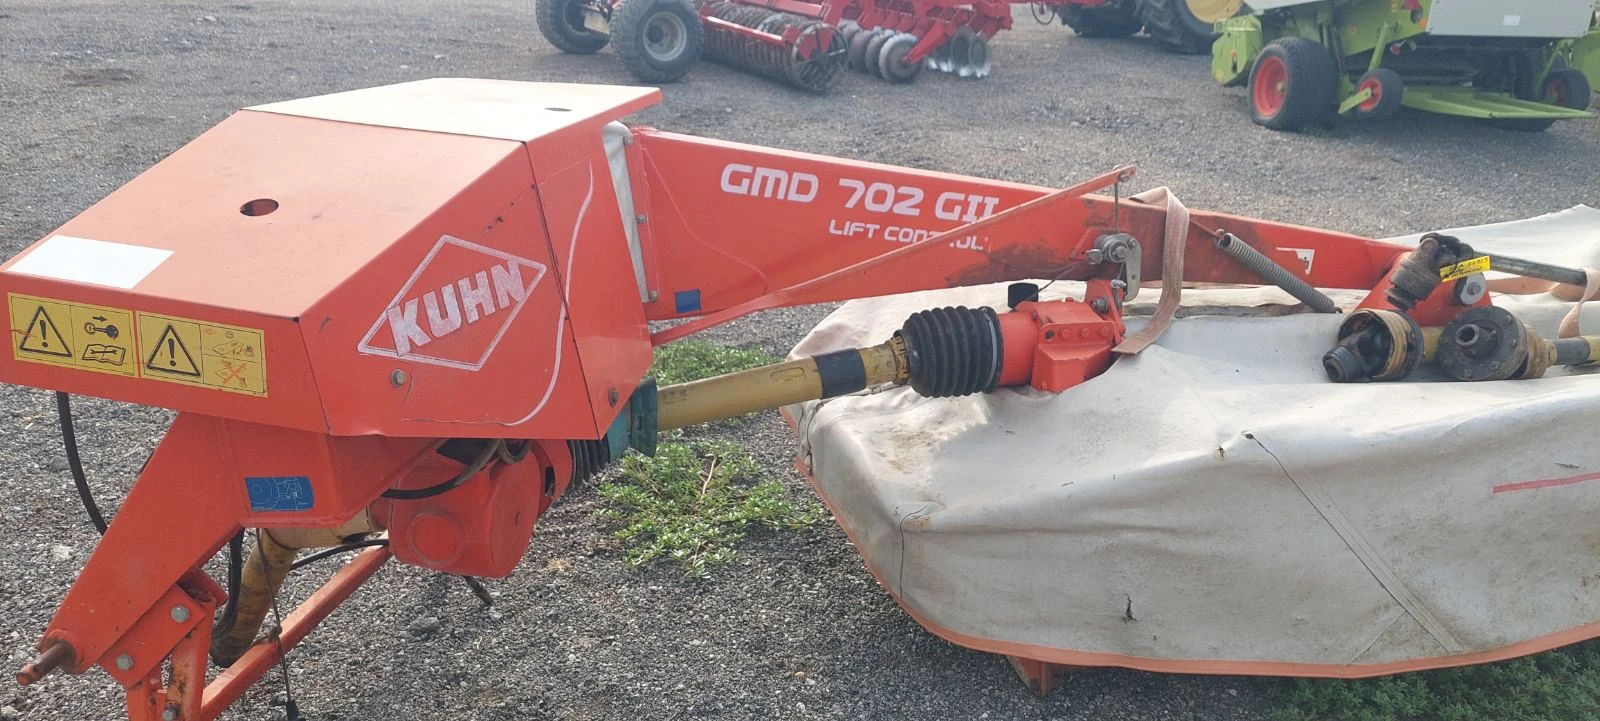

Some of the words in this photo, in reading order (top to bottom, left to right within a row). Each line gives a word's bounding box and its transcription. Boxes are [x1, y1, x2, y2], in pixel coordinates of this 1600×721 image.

[720, 163, 819, 203] GMD
[838, 178, 925, 216] 702
[935, 191, 1000, 224] GII
[829, 219, 880, 239] LIFT
[884, 227, 984, 250] CONOL
[386, 256, 527, 357] KUHN
